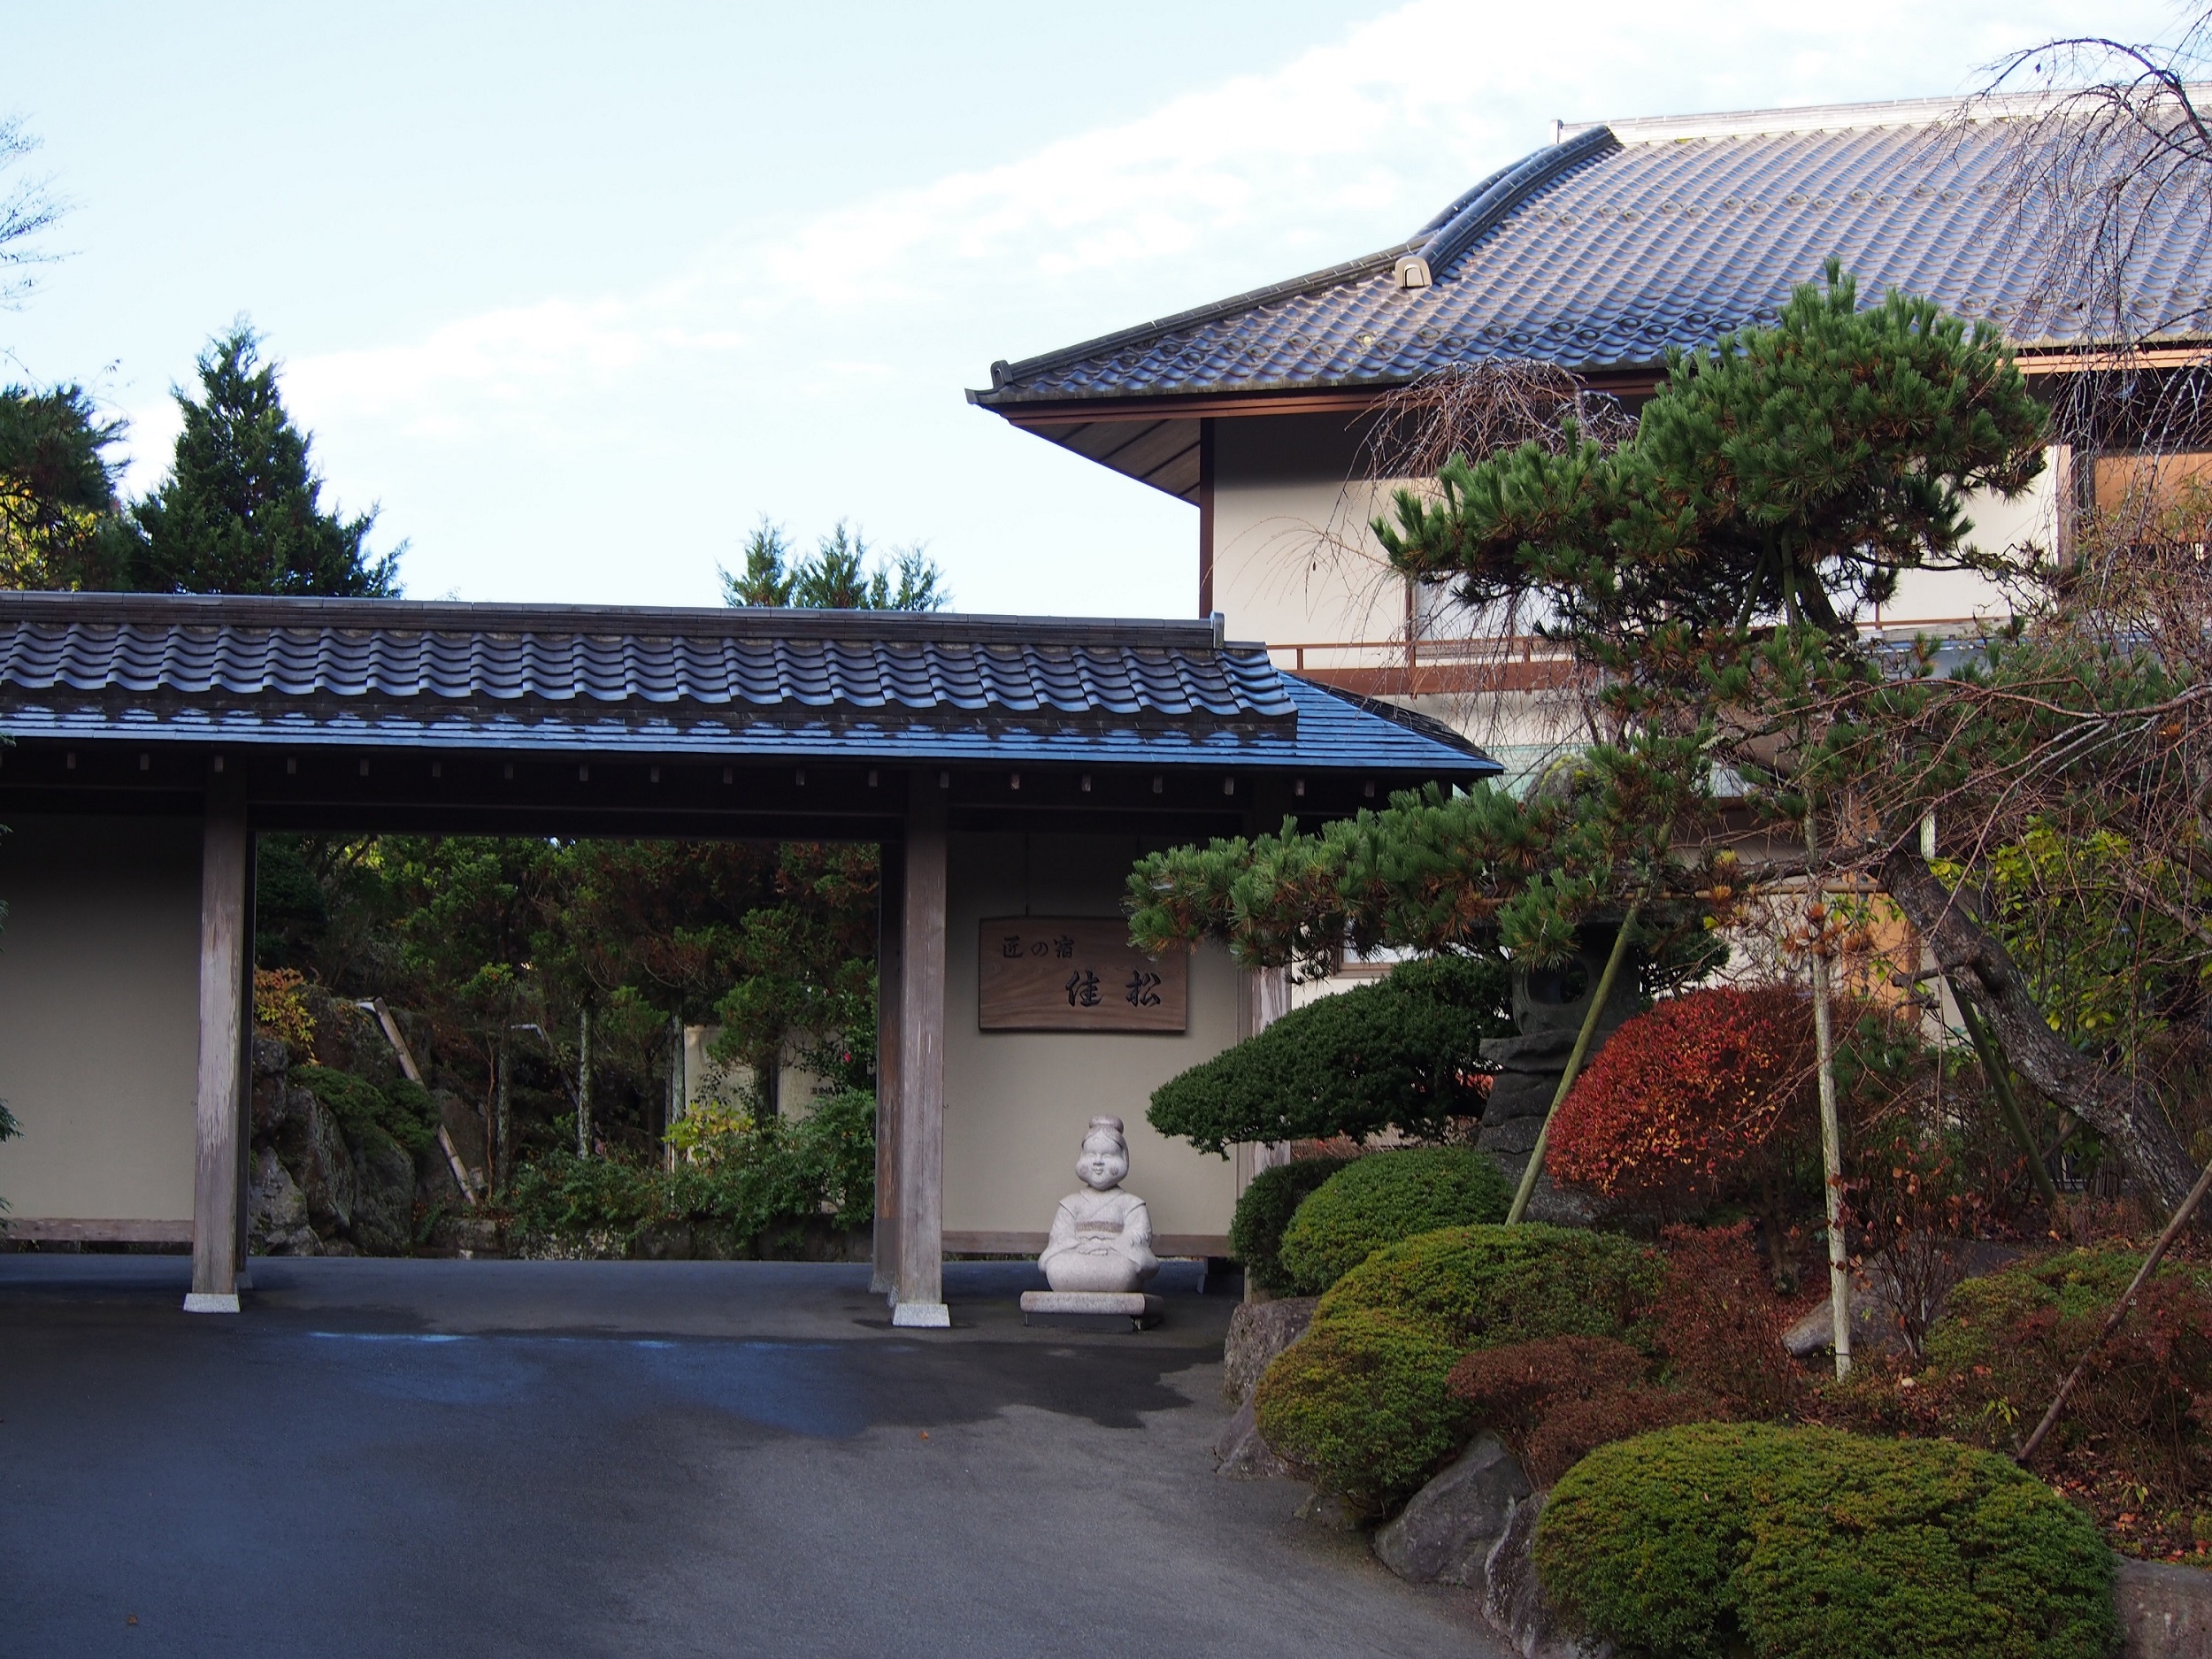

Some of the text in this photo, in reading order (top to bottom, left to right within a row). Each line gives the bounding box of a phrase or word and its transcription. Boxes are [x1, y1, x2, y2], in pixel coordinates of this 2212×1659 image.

[1002, 934, 1075, 958] 匠の宿
[1065, 970, 1162, 1007] 佳松
